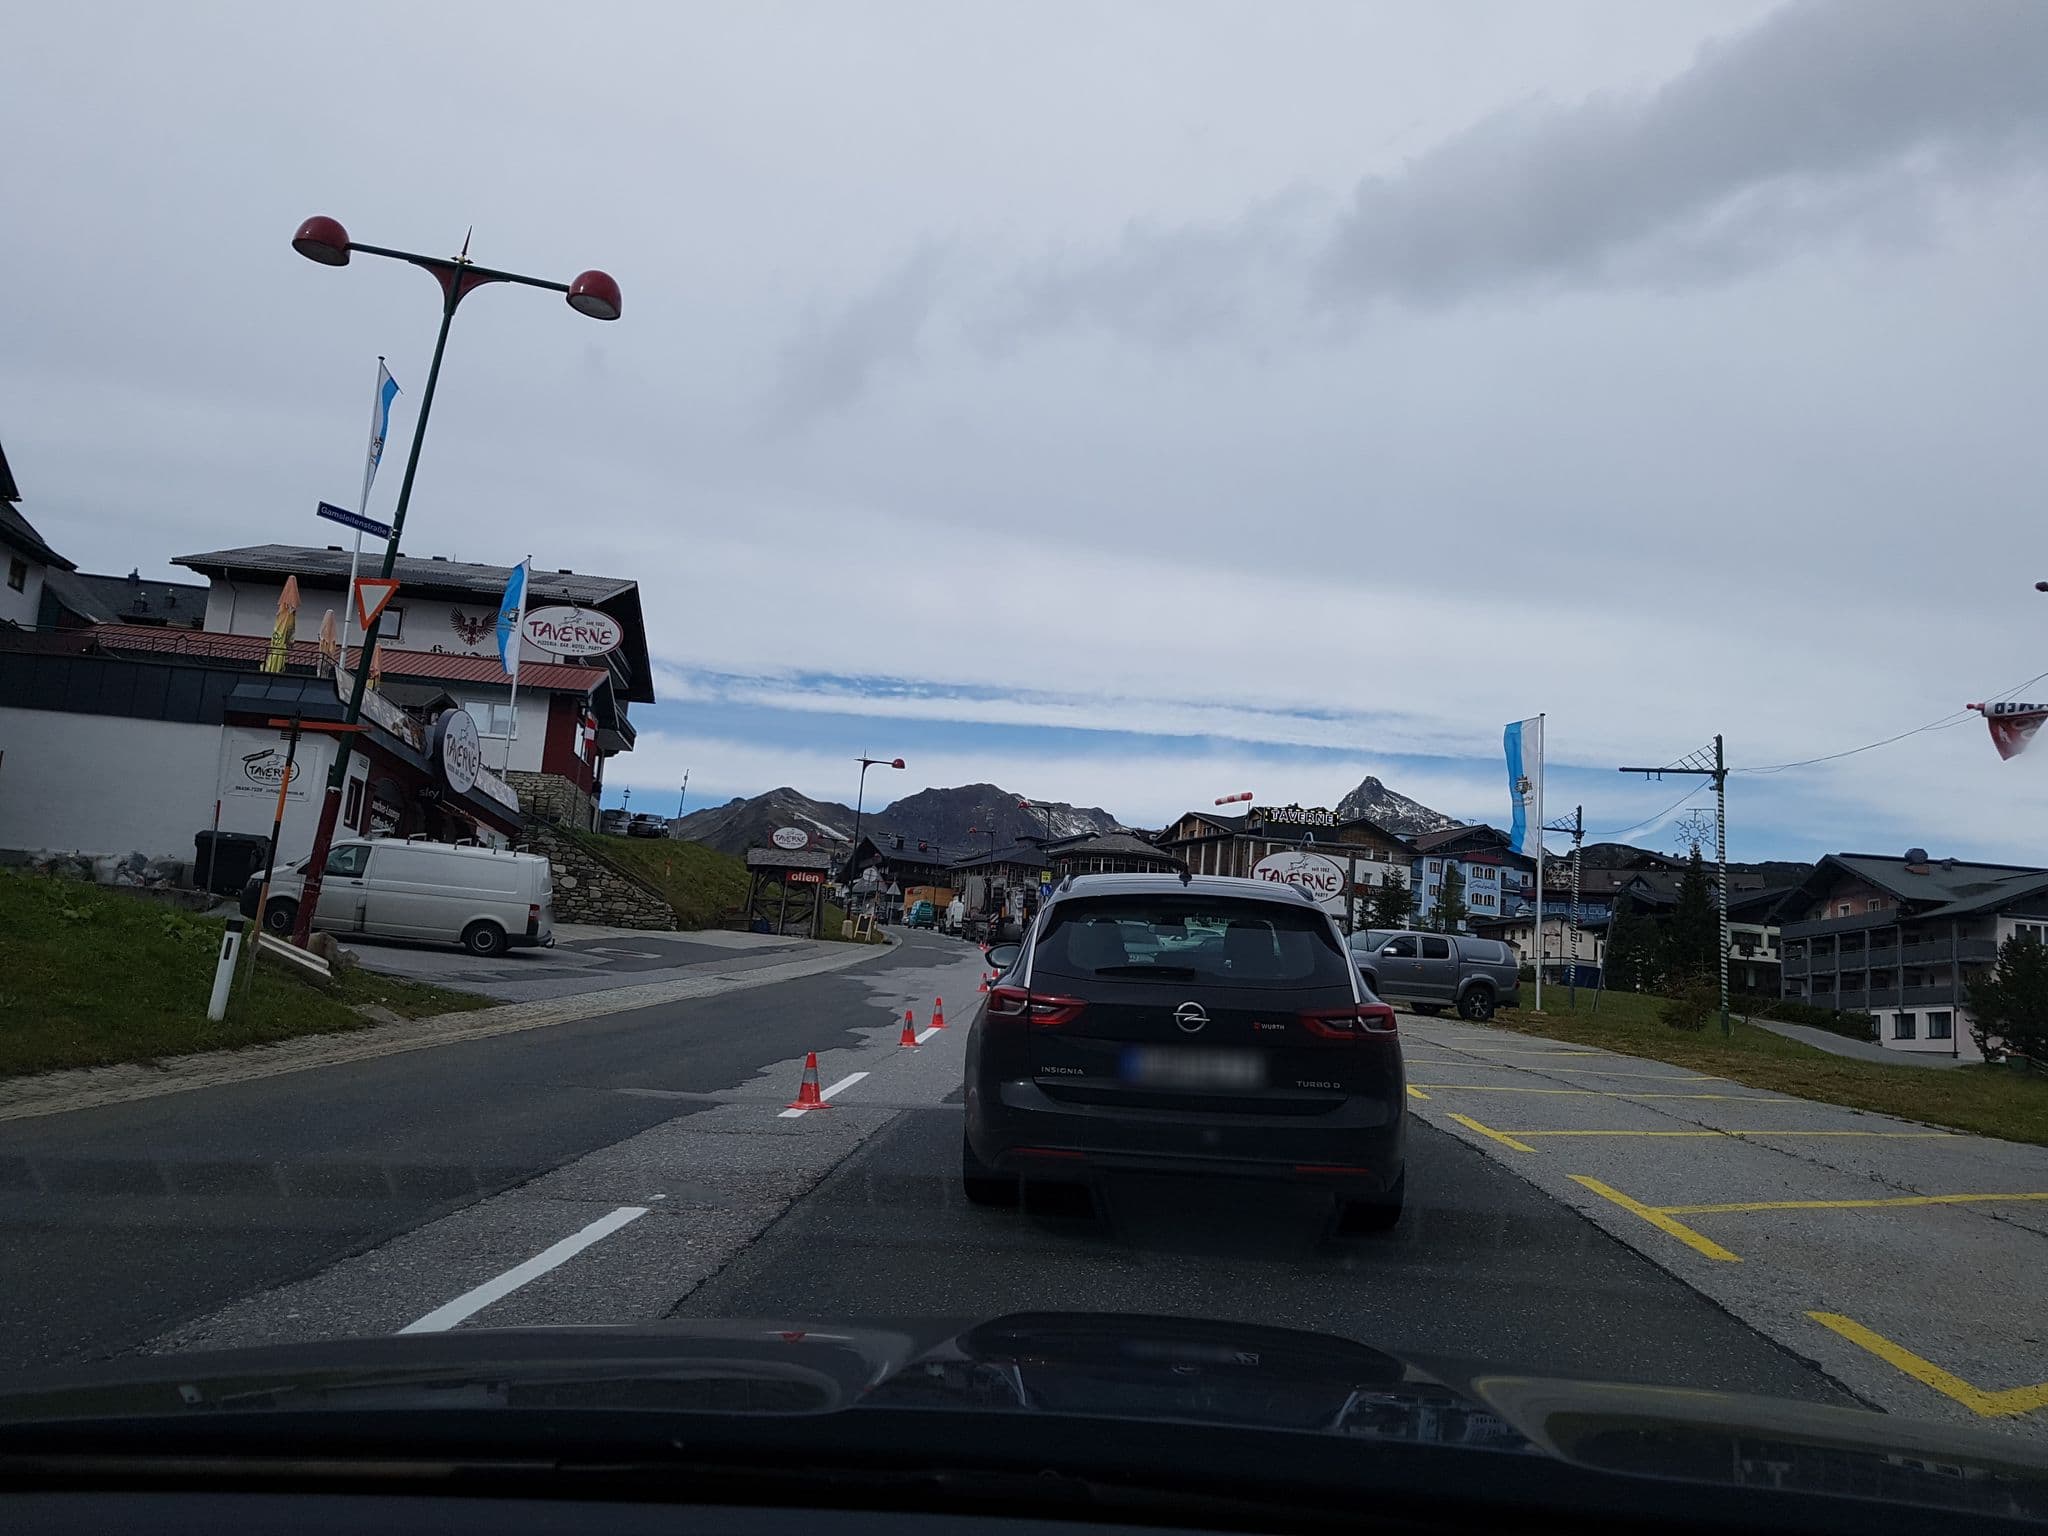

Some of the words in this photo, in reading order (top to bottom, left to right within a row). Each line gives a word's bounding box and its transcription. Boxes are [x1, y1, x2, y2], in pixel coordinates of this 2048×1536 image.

[320, 506, 387, 535] Gamsleitenstraße
[528, 620, 612, 646] TAVERNE
[447, 733, 477, 776] TAVERNE
[249, 765, 294, 779] TAVERE
[418, 786, 440, 799] sky
[1271, 809, 1334, 825] TAVERNE
[1258, 867, 1337, 892] TAVERNE
[1040, 1065, 1084, 1075] INSIGNIA
[1295, 1080, 1331, 1089] TURBO
[1333, 1081, 1341, 1089] D
